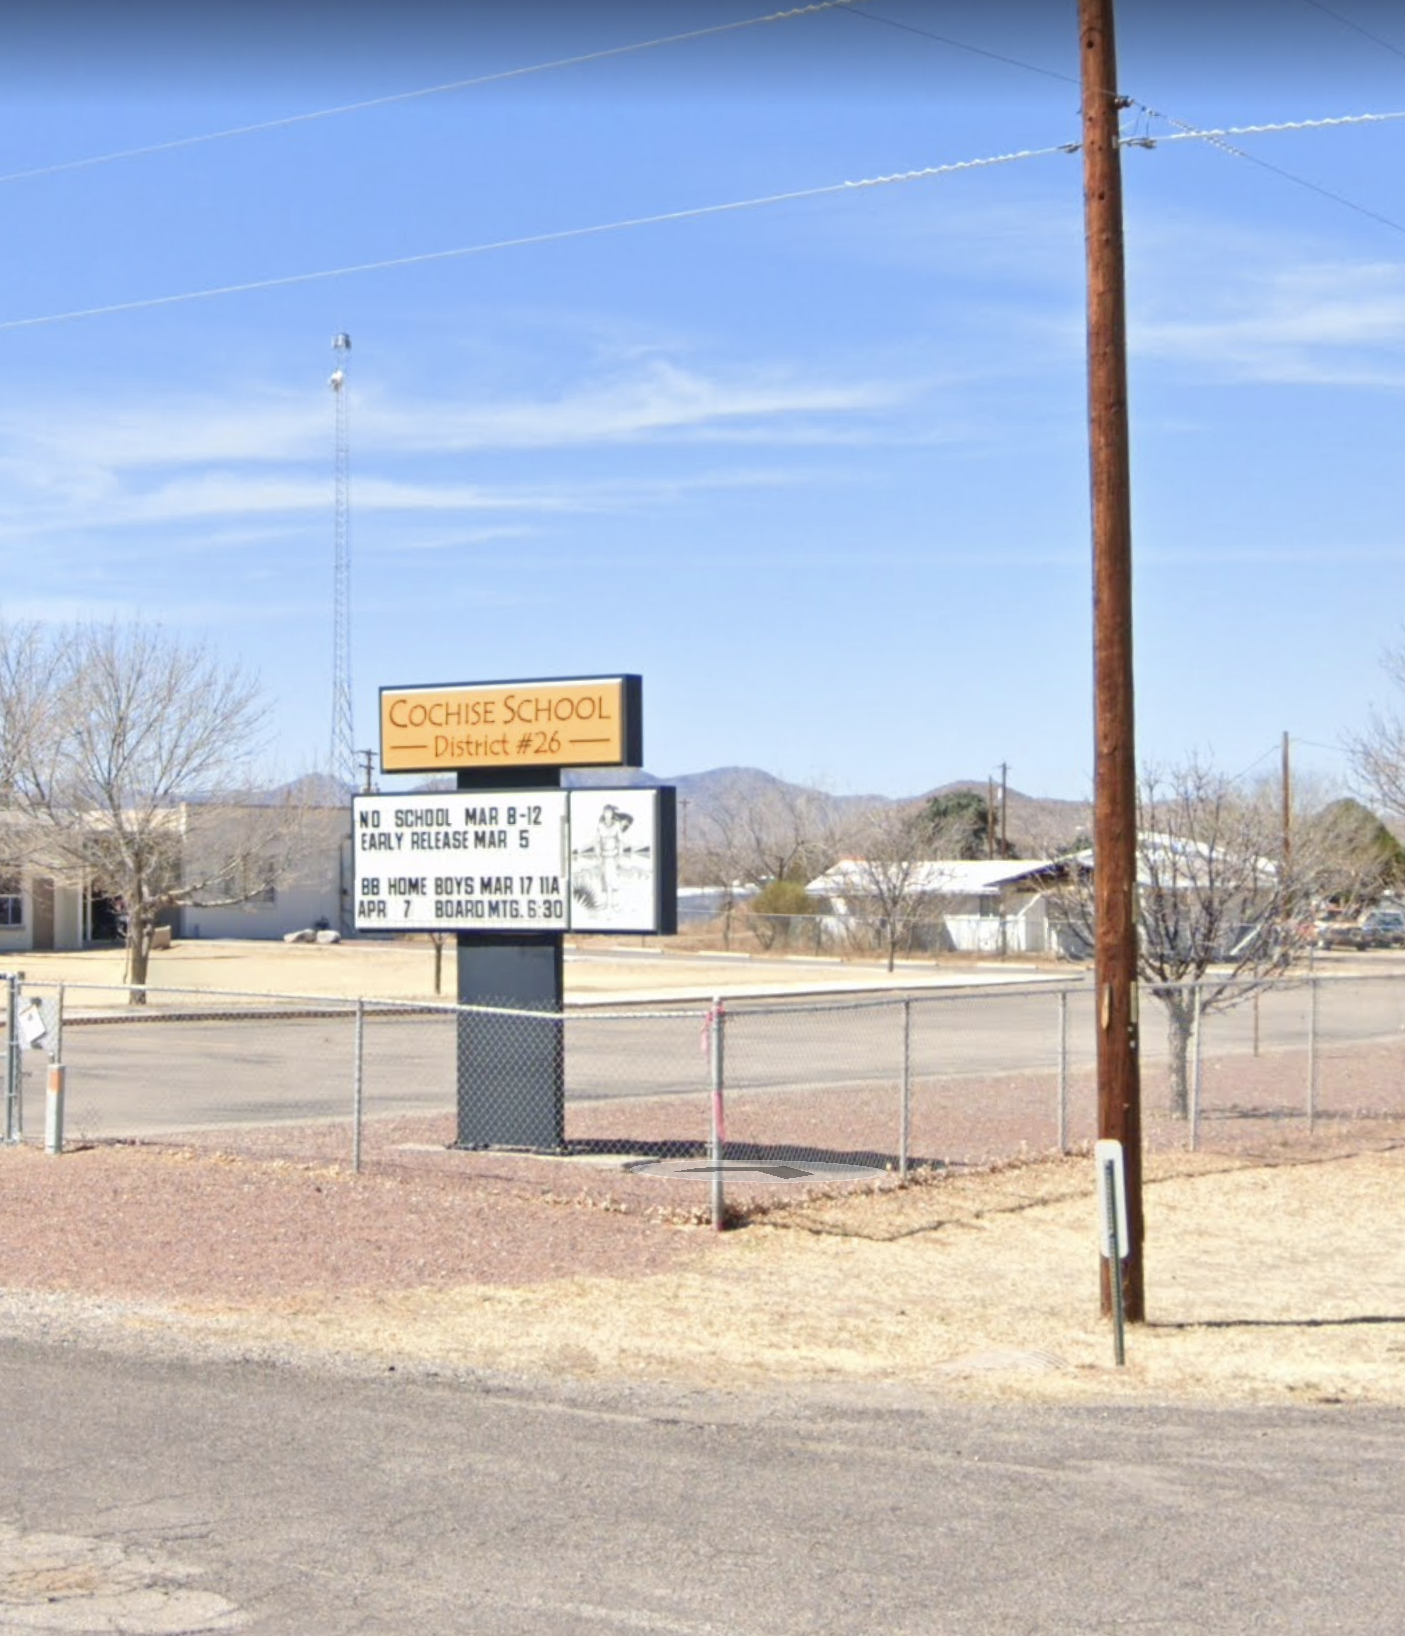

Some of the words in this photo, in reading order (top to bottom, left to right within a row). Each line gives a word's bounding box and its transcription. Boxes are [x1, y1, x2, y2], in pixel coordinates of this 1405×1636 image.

[389, 699, 495, 728] COCHISE
[503, 694, 611, 724] SCHOOL
[434, 732, 509, 757] District
[516, 730, 561, 755] #26
[359, 809, 381, 828] NO
[394, 807, 452, 828] SCHOOL
[464, 806, 499, 826] MAR
[506, 805, 542, 826] 8-12
[361, 832, 404, 851] EARLY
[410, 830, 469, 850] RELEASE
[473, 829, 507, 850] MAR
[519, 829, 530, 849] 5
[361, 877, 380, 896] BB
[388, 876, 427, 896] HOME
[434, 876, 475, 896] BOYS
[479, 876, 513, 896] MAR
[519, 876, 534, 896] 17
[358, 899, 386, 919] APR
[403, 899, 411, 918] 7
[434, 899, 485, 919] BOARD
[487, 899, 524, 919] MTG.
[527, 899, 564, 919] 6:30
